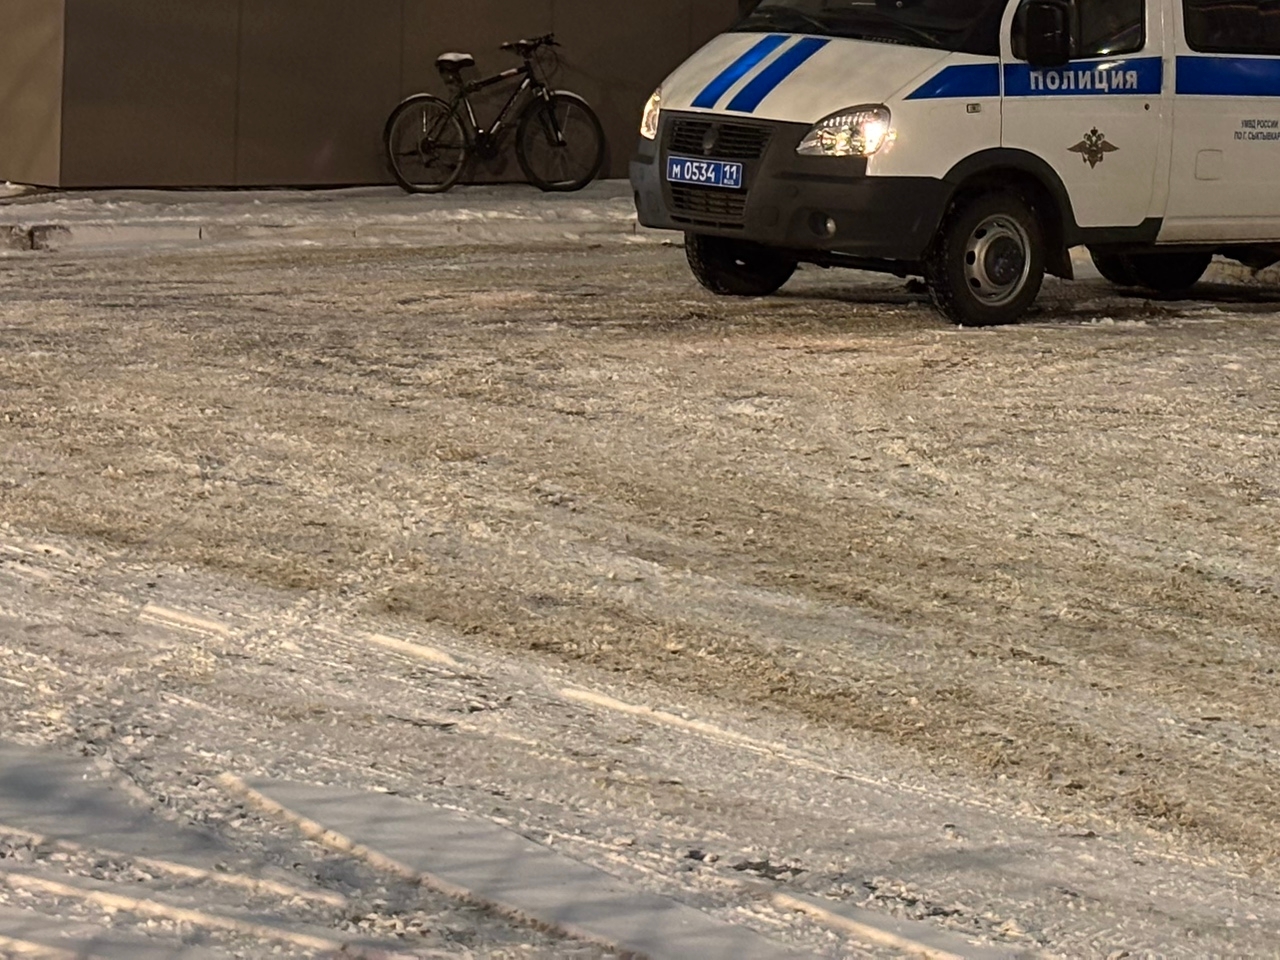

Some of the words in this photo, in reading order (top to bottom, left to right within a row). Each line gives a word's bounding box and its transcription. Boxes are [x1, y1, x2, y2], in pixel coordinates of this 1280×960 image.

[1030, 70, 1138, 92] ПОЛИЦИЯ
[1256, 119, 1279, 129] РОССИИ
[1234, 131, 1242, 140] ПО
[684, 161, 715, 182] 0534
[723, 164, 737, 180] 11
